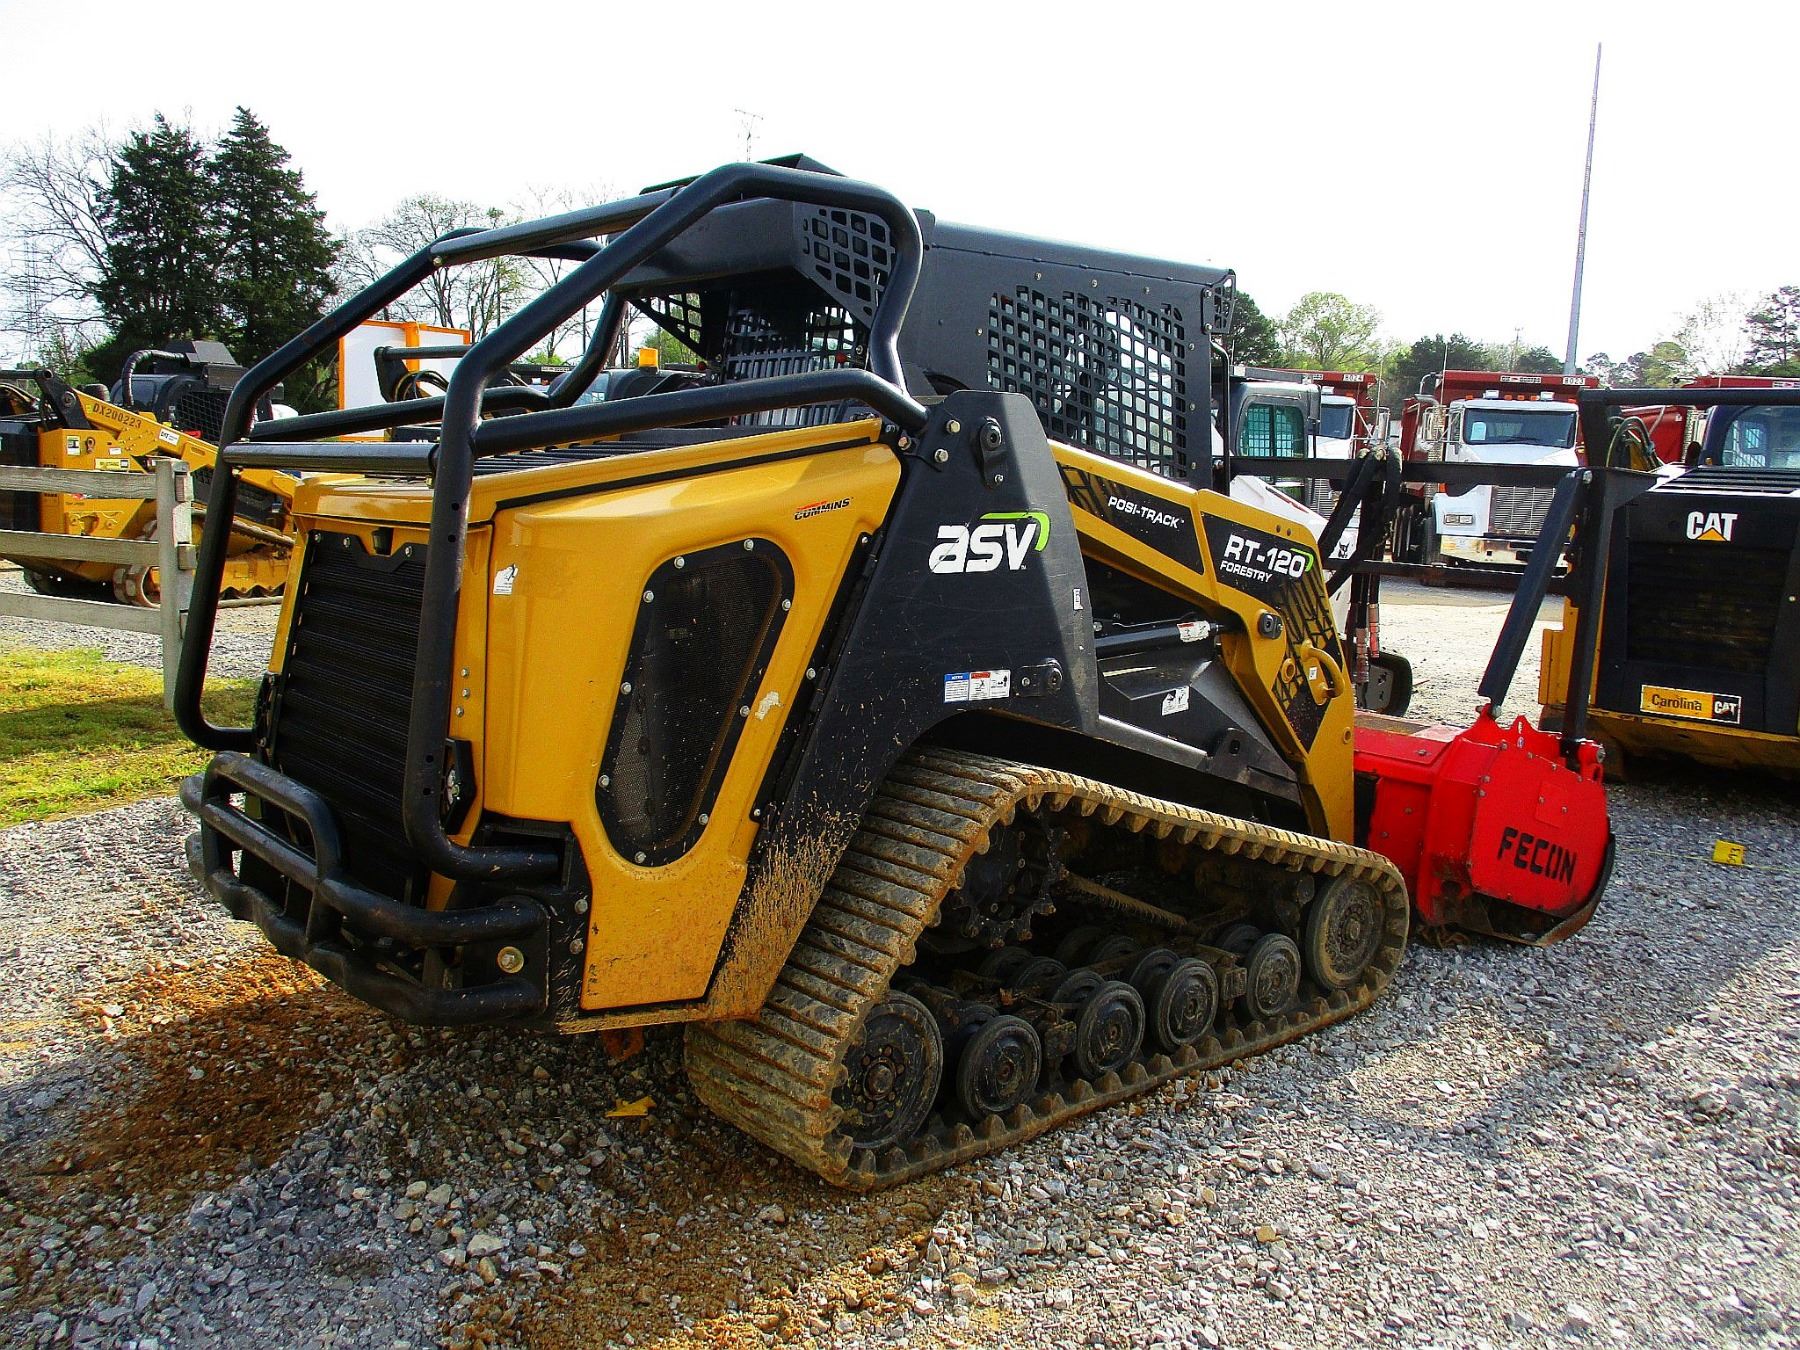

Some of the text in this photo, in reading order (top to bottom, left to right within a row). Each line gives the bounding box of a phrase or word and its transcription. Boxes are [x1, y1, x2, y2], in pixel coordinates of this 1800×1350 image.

[794, 498, 850, 520] CUMMINS
[1107, 496, 1180, 529] POSI-TRACK
[1686, 511, 1738, 541] CAT
[1224, 533, 1307, 578] RT-120
[1219, 560, 1273, 583] FORESTRY
[1652, 693, 1739, 716] Carolina CAT
[1497, 826, 1578, 887] FECON
